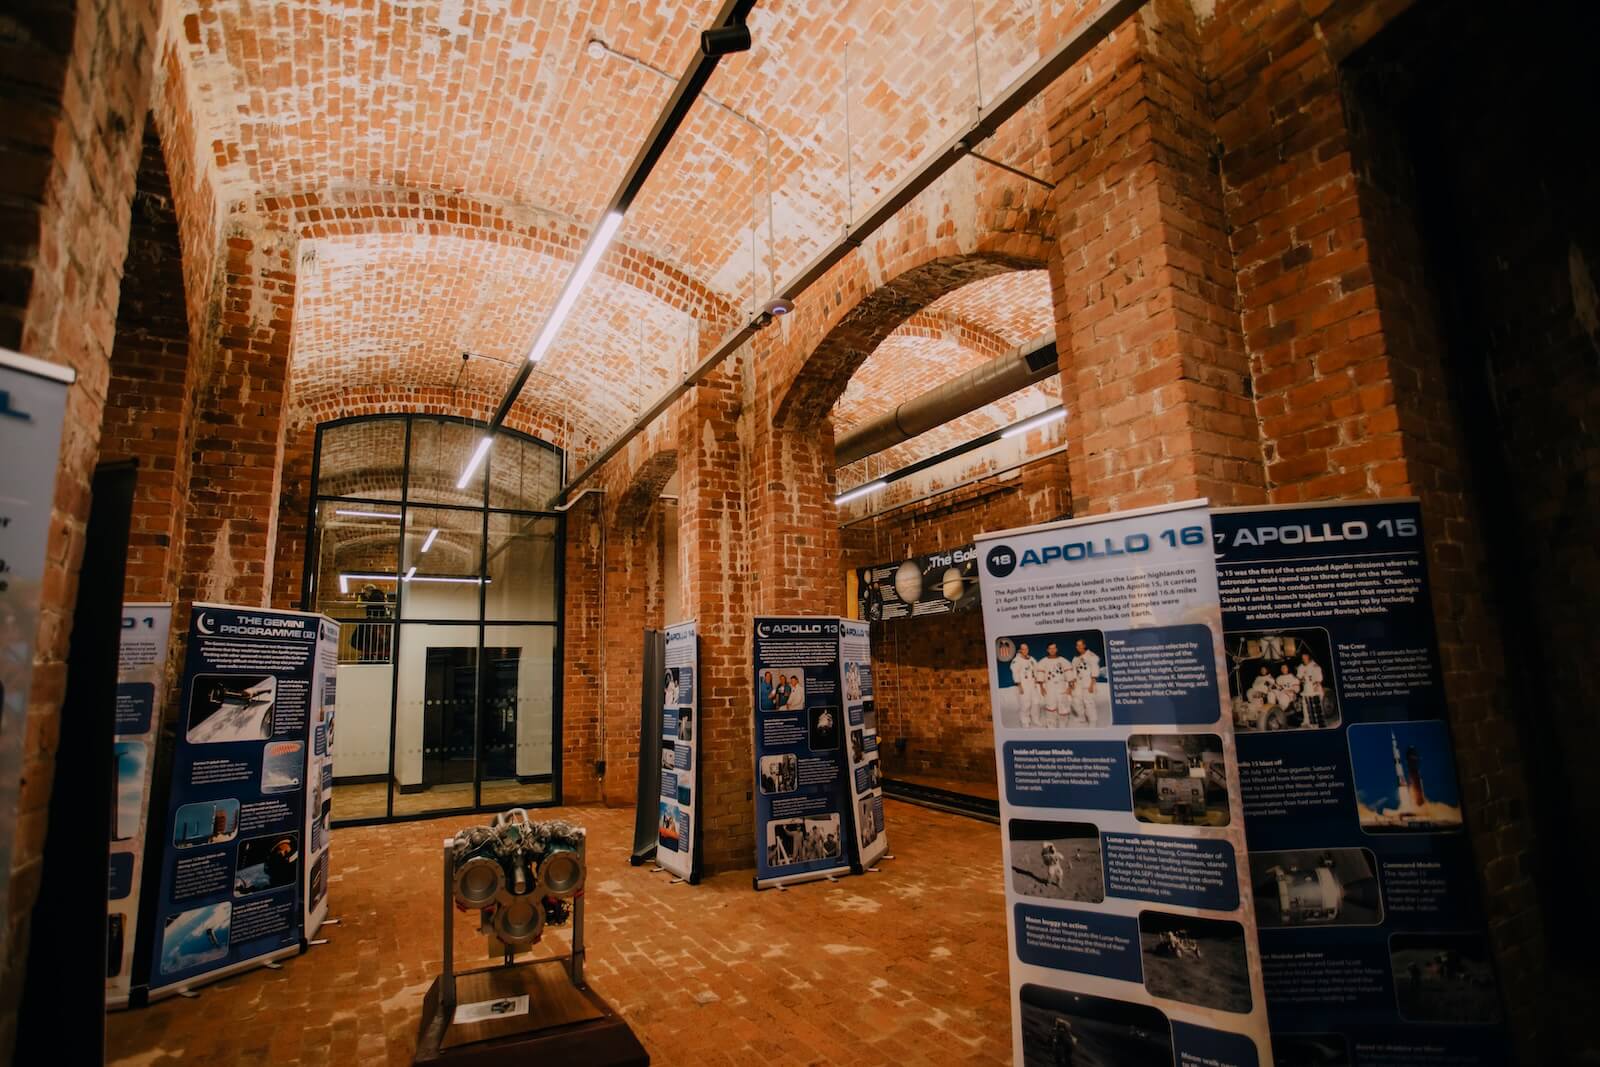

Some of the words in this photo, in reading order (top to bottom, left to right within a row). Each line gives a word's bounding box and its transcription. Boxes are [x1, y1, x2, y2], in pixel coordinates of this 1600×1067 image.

[1214, 534, 1225, 544] 7
[1232, 520, 1368, 547] APOLLO
[1376, 518, 1418, 538] 15
[992, 554, 1010, 565] 18
[1020, 533, 1150, 568] APOLLO
[1160, 526, 1204, 548] 16
[929, 556, 952, 567] The
[953, 548, 976, 563] Sola
[237, 616, 262, 625] THE
[264, 618, 304, 629] GEMINI
[772, 625, 821, 633] APOLLO
[220, 625, 302, 638] PROGRAMME
[303, 631, 316, 639] (2)
[1157, 841, 1197, 849] experiments
[1042, 918, 1060, 928] buggy
